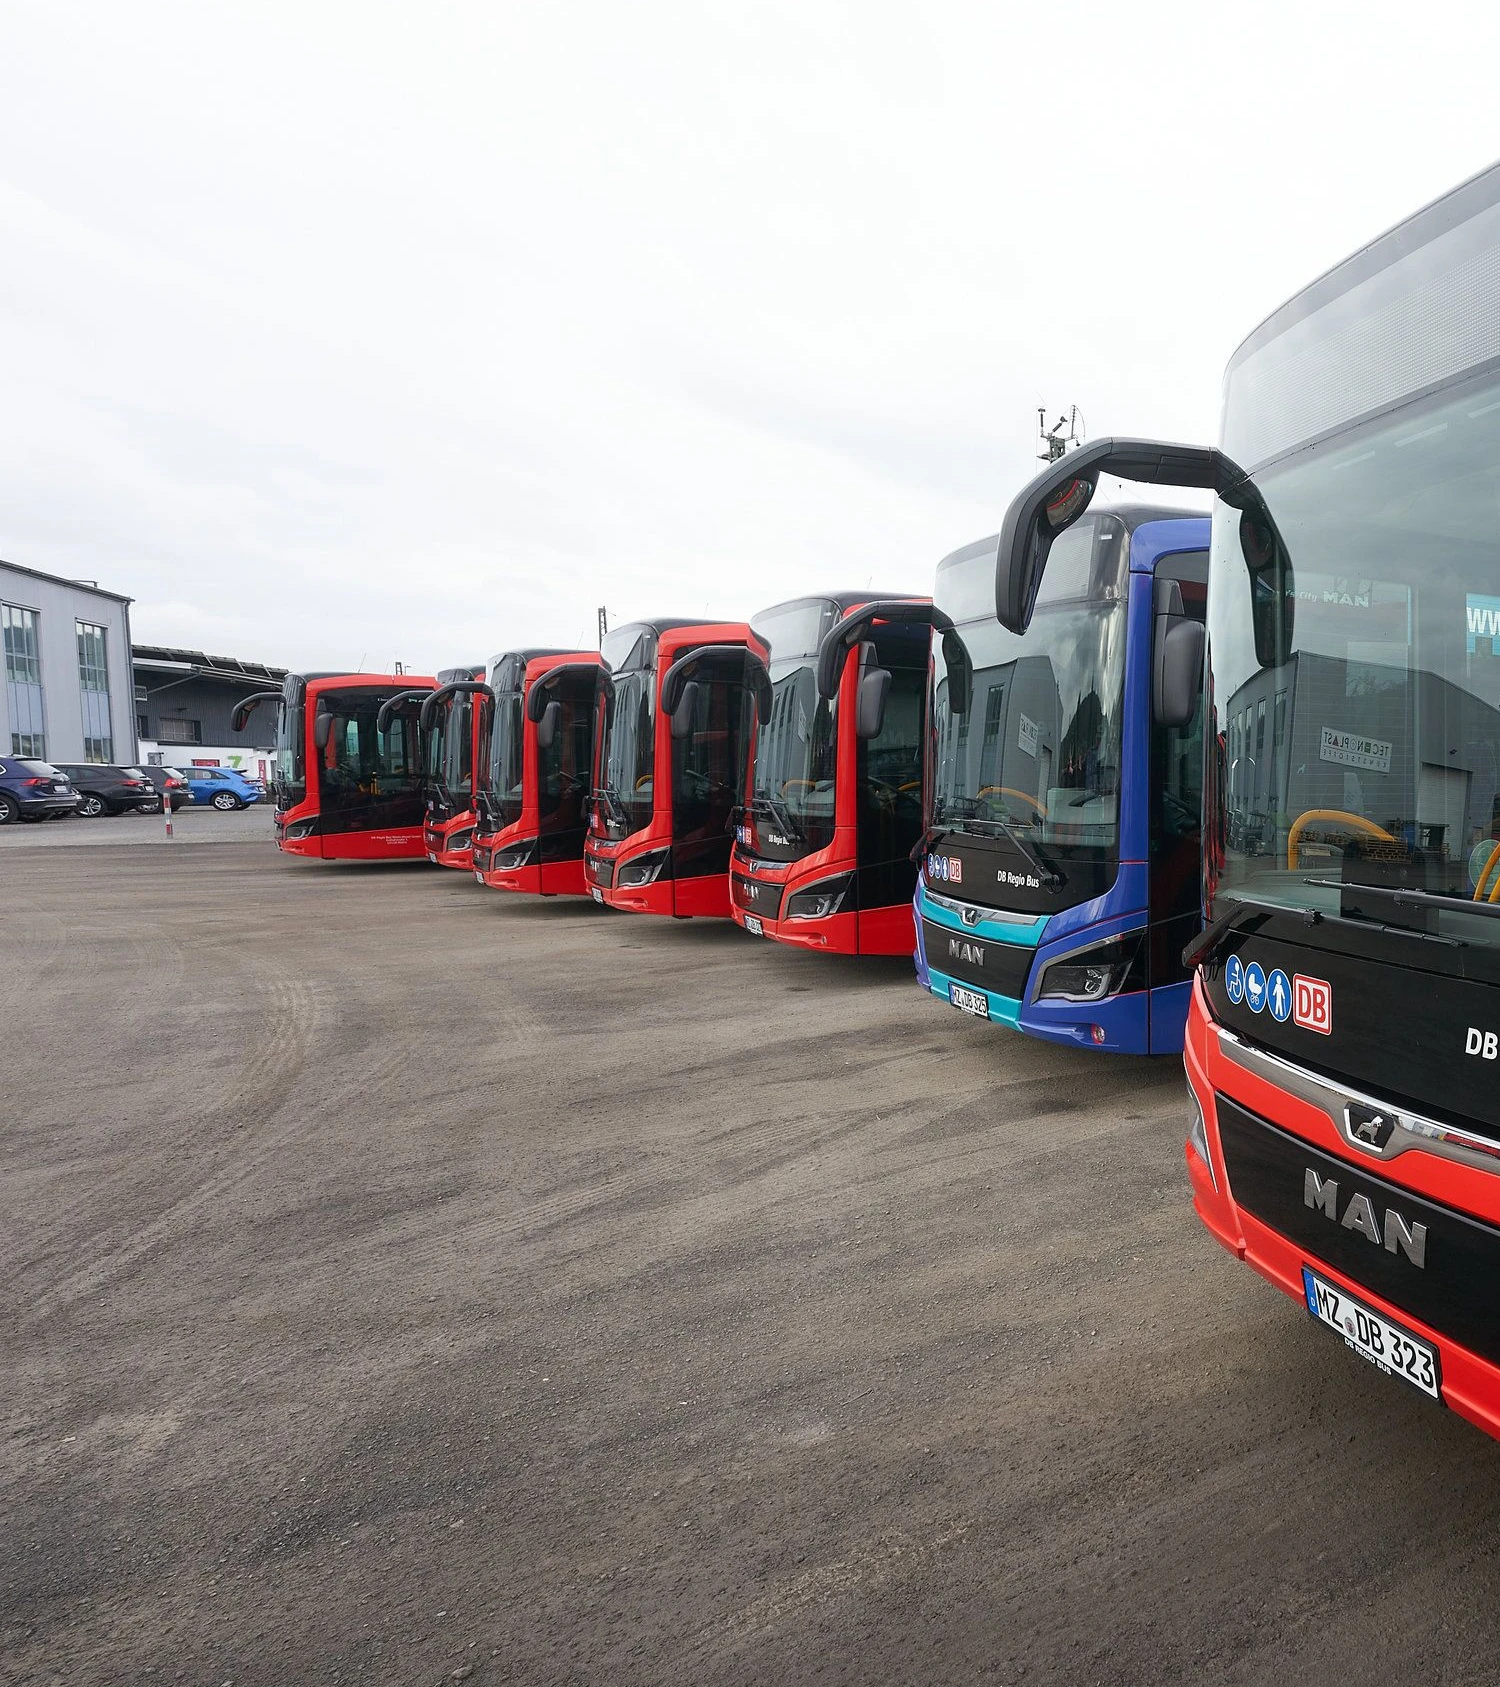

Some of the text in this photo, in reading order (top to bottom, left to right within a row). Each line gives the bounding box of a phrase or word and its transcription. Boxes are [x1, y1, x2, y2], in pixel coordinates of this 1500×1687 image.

[1323, 590, 1369, 608] MAN
[950, 861, 961, 880] DB
[997, 869, 1040, 889] DB Regio Bus
[948, 938, 986, 967] MAN
[1298, 983, 1327, 1024] DB
[1464, 1026, 1499, 1061] DB
[1304, 1167, 1429, 1270] MAN
[1315, 1282, 1344, 1330] MZ
[1354, 1308, 1385, 1356] DB
[1388, 1330, 1435, 1389] 323
[1344, 1337, 1392, 1376] DB REGIO BUS
